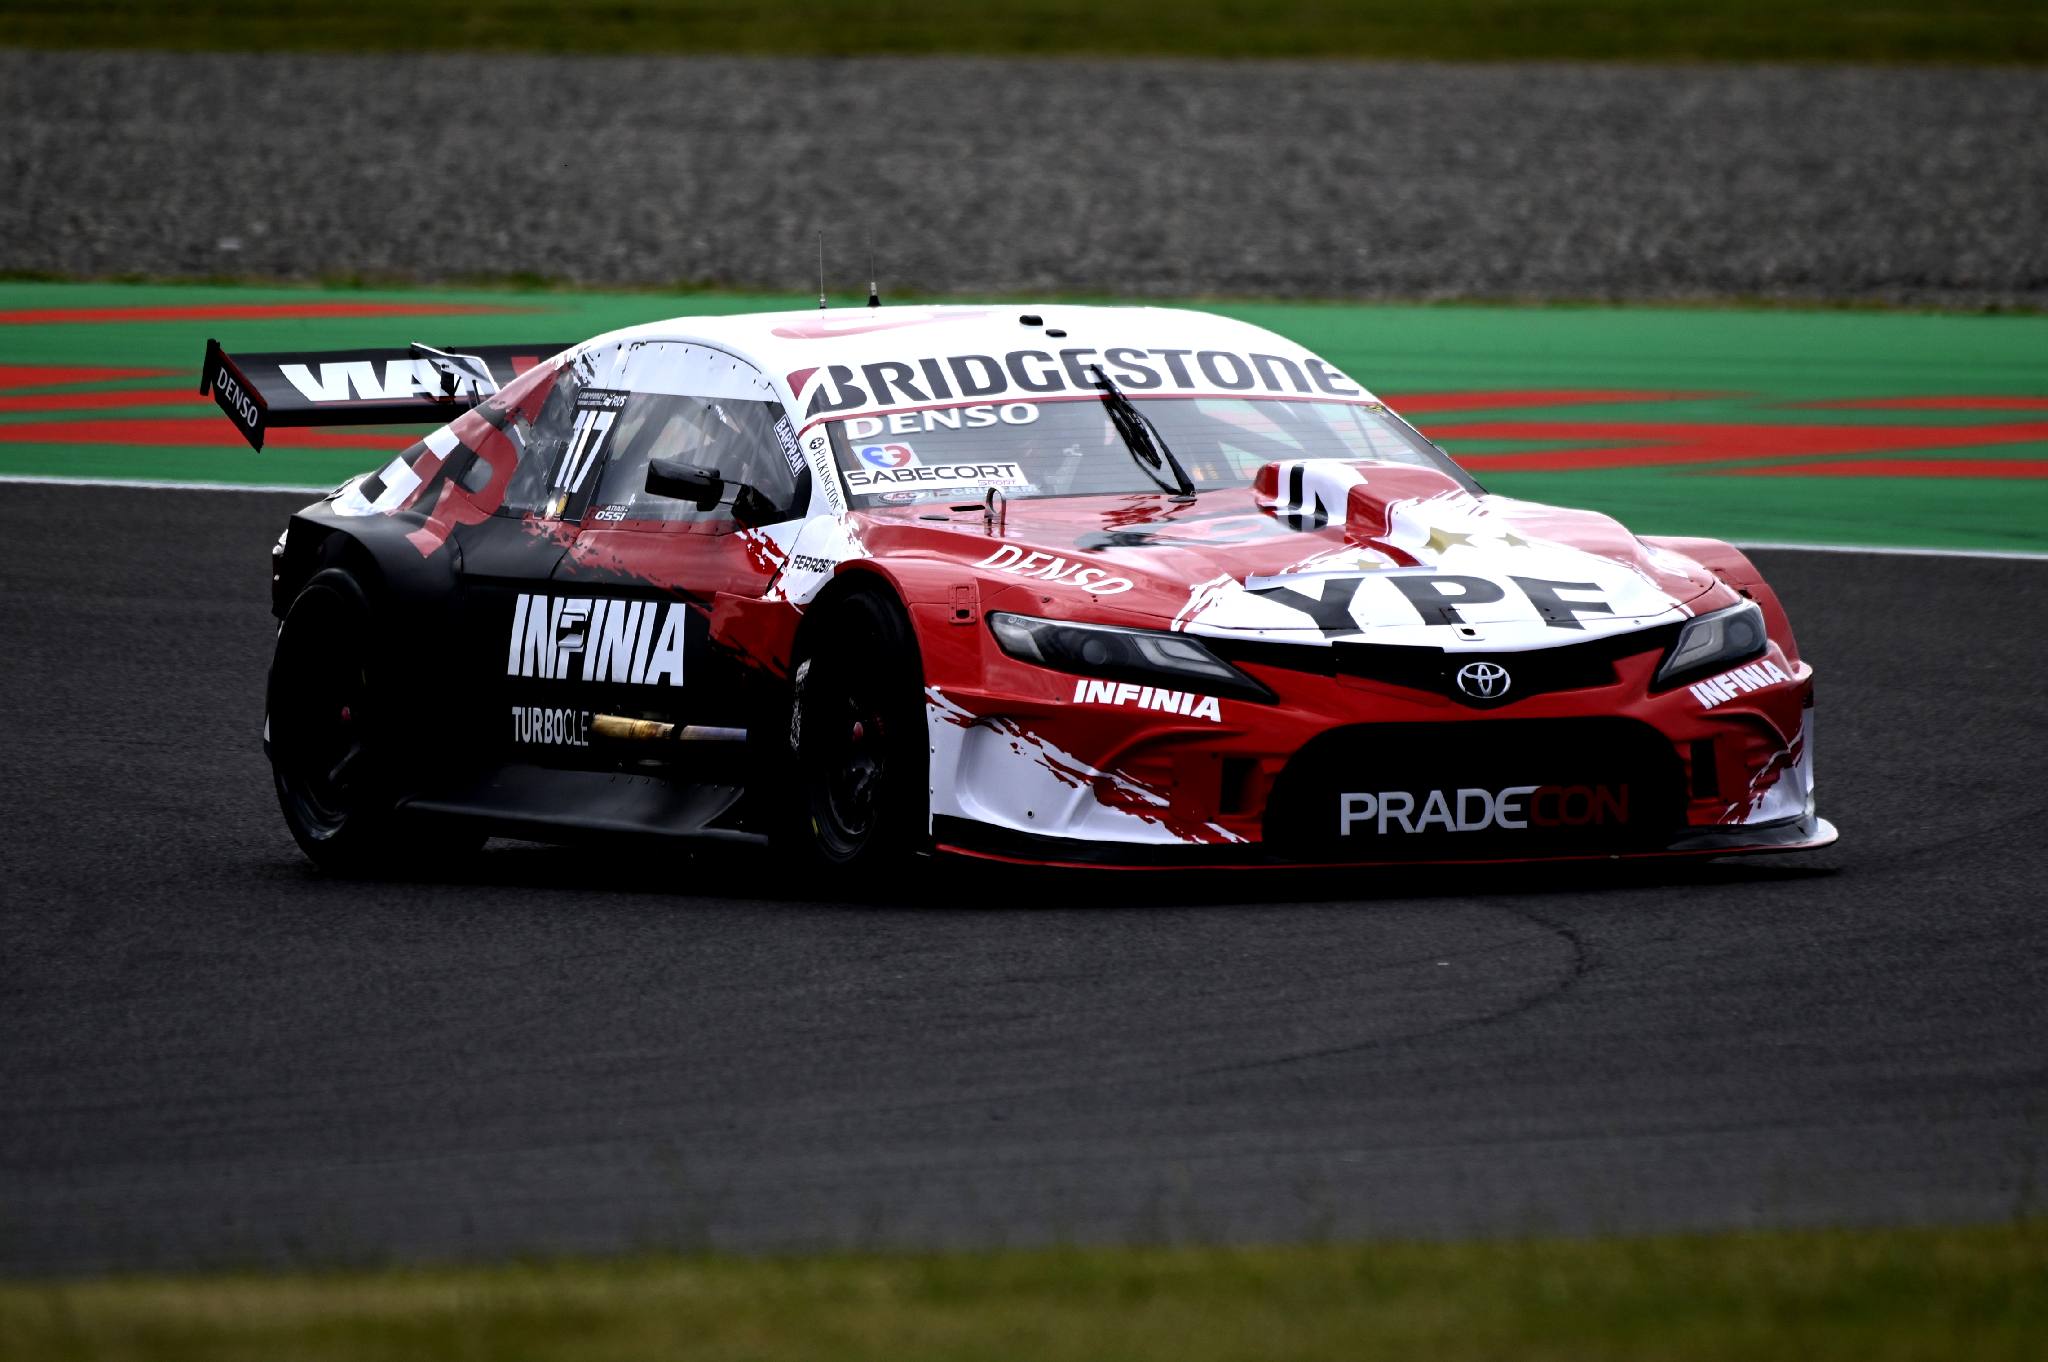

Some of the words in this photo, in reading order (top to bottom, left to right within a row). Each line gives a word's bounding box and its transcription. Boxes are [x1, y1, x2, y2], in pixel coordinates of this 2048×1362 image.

[217, 366, 258, 428] DENSO
[786, 348, 1359, 420] BRIDGESTONE
[776, 416, 806, 474] BARPRAN
[843, 403, 1040, 441] DENSO
[812, 447, 841, 511] PILKINGTON
[847, 464, 1016, 486] SABECORT
[972, 544, 1134, 595] DENSO
[1248, 574, 1616, 638] YPF
[507, 593, 686, 687] INFINIA
[1073, 679, 1222, 722] INFINIA
[1689, 660, 1791, 709] INFINIA
[1341, 783, 1631, 836] PRADECON
